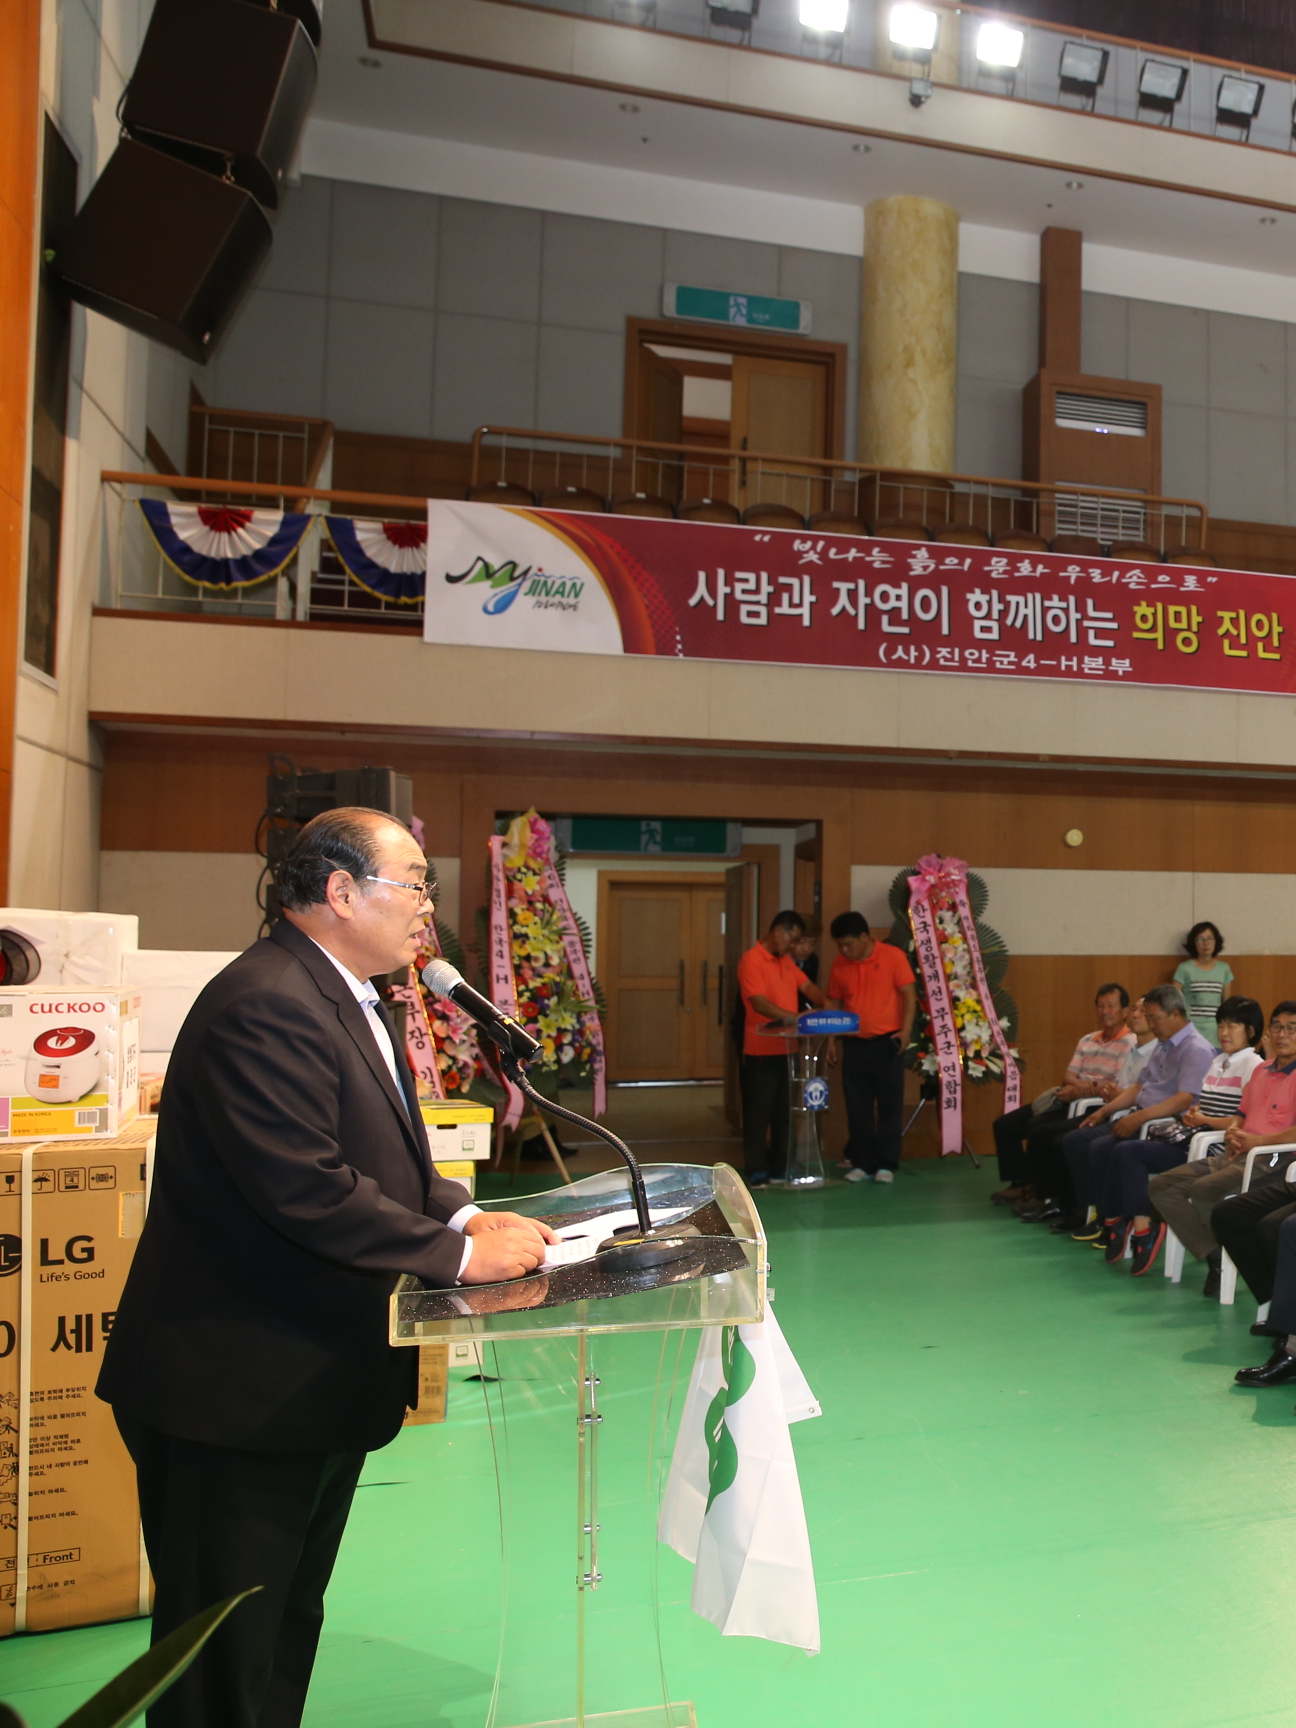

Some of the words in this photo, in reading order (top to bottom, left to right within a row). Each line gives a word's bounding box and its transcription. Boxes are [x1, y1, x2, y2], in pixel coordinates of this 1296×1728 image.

[907, 547, 972, 576] 흙의
[983, 556, 1051, 579] 문화
[523, 579, 585, 599] JINAN
[688, 567, 818, 628] 사람과
[830, 578, 950, 636] 자연이
[966, 587, 1119, 648] 함께하는
[1132, 600, 1203, 655] 희망
[1216, 608, 1284, 661] 진안
[878, 642, 1133, 676] (사)진안군4-H본부
[29, 1002, 106, 1014] CUCKOO
[933, 1006, 956, 1056] 무주군
[942, 1061, 962, 1111] 연합회
[40, 1235, 95, 1267] LG
[40, 1271, 70, 1283] Life's
[74, 1269, 105, 1281] Good
[43, 1551, 74, 1563] Front
